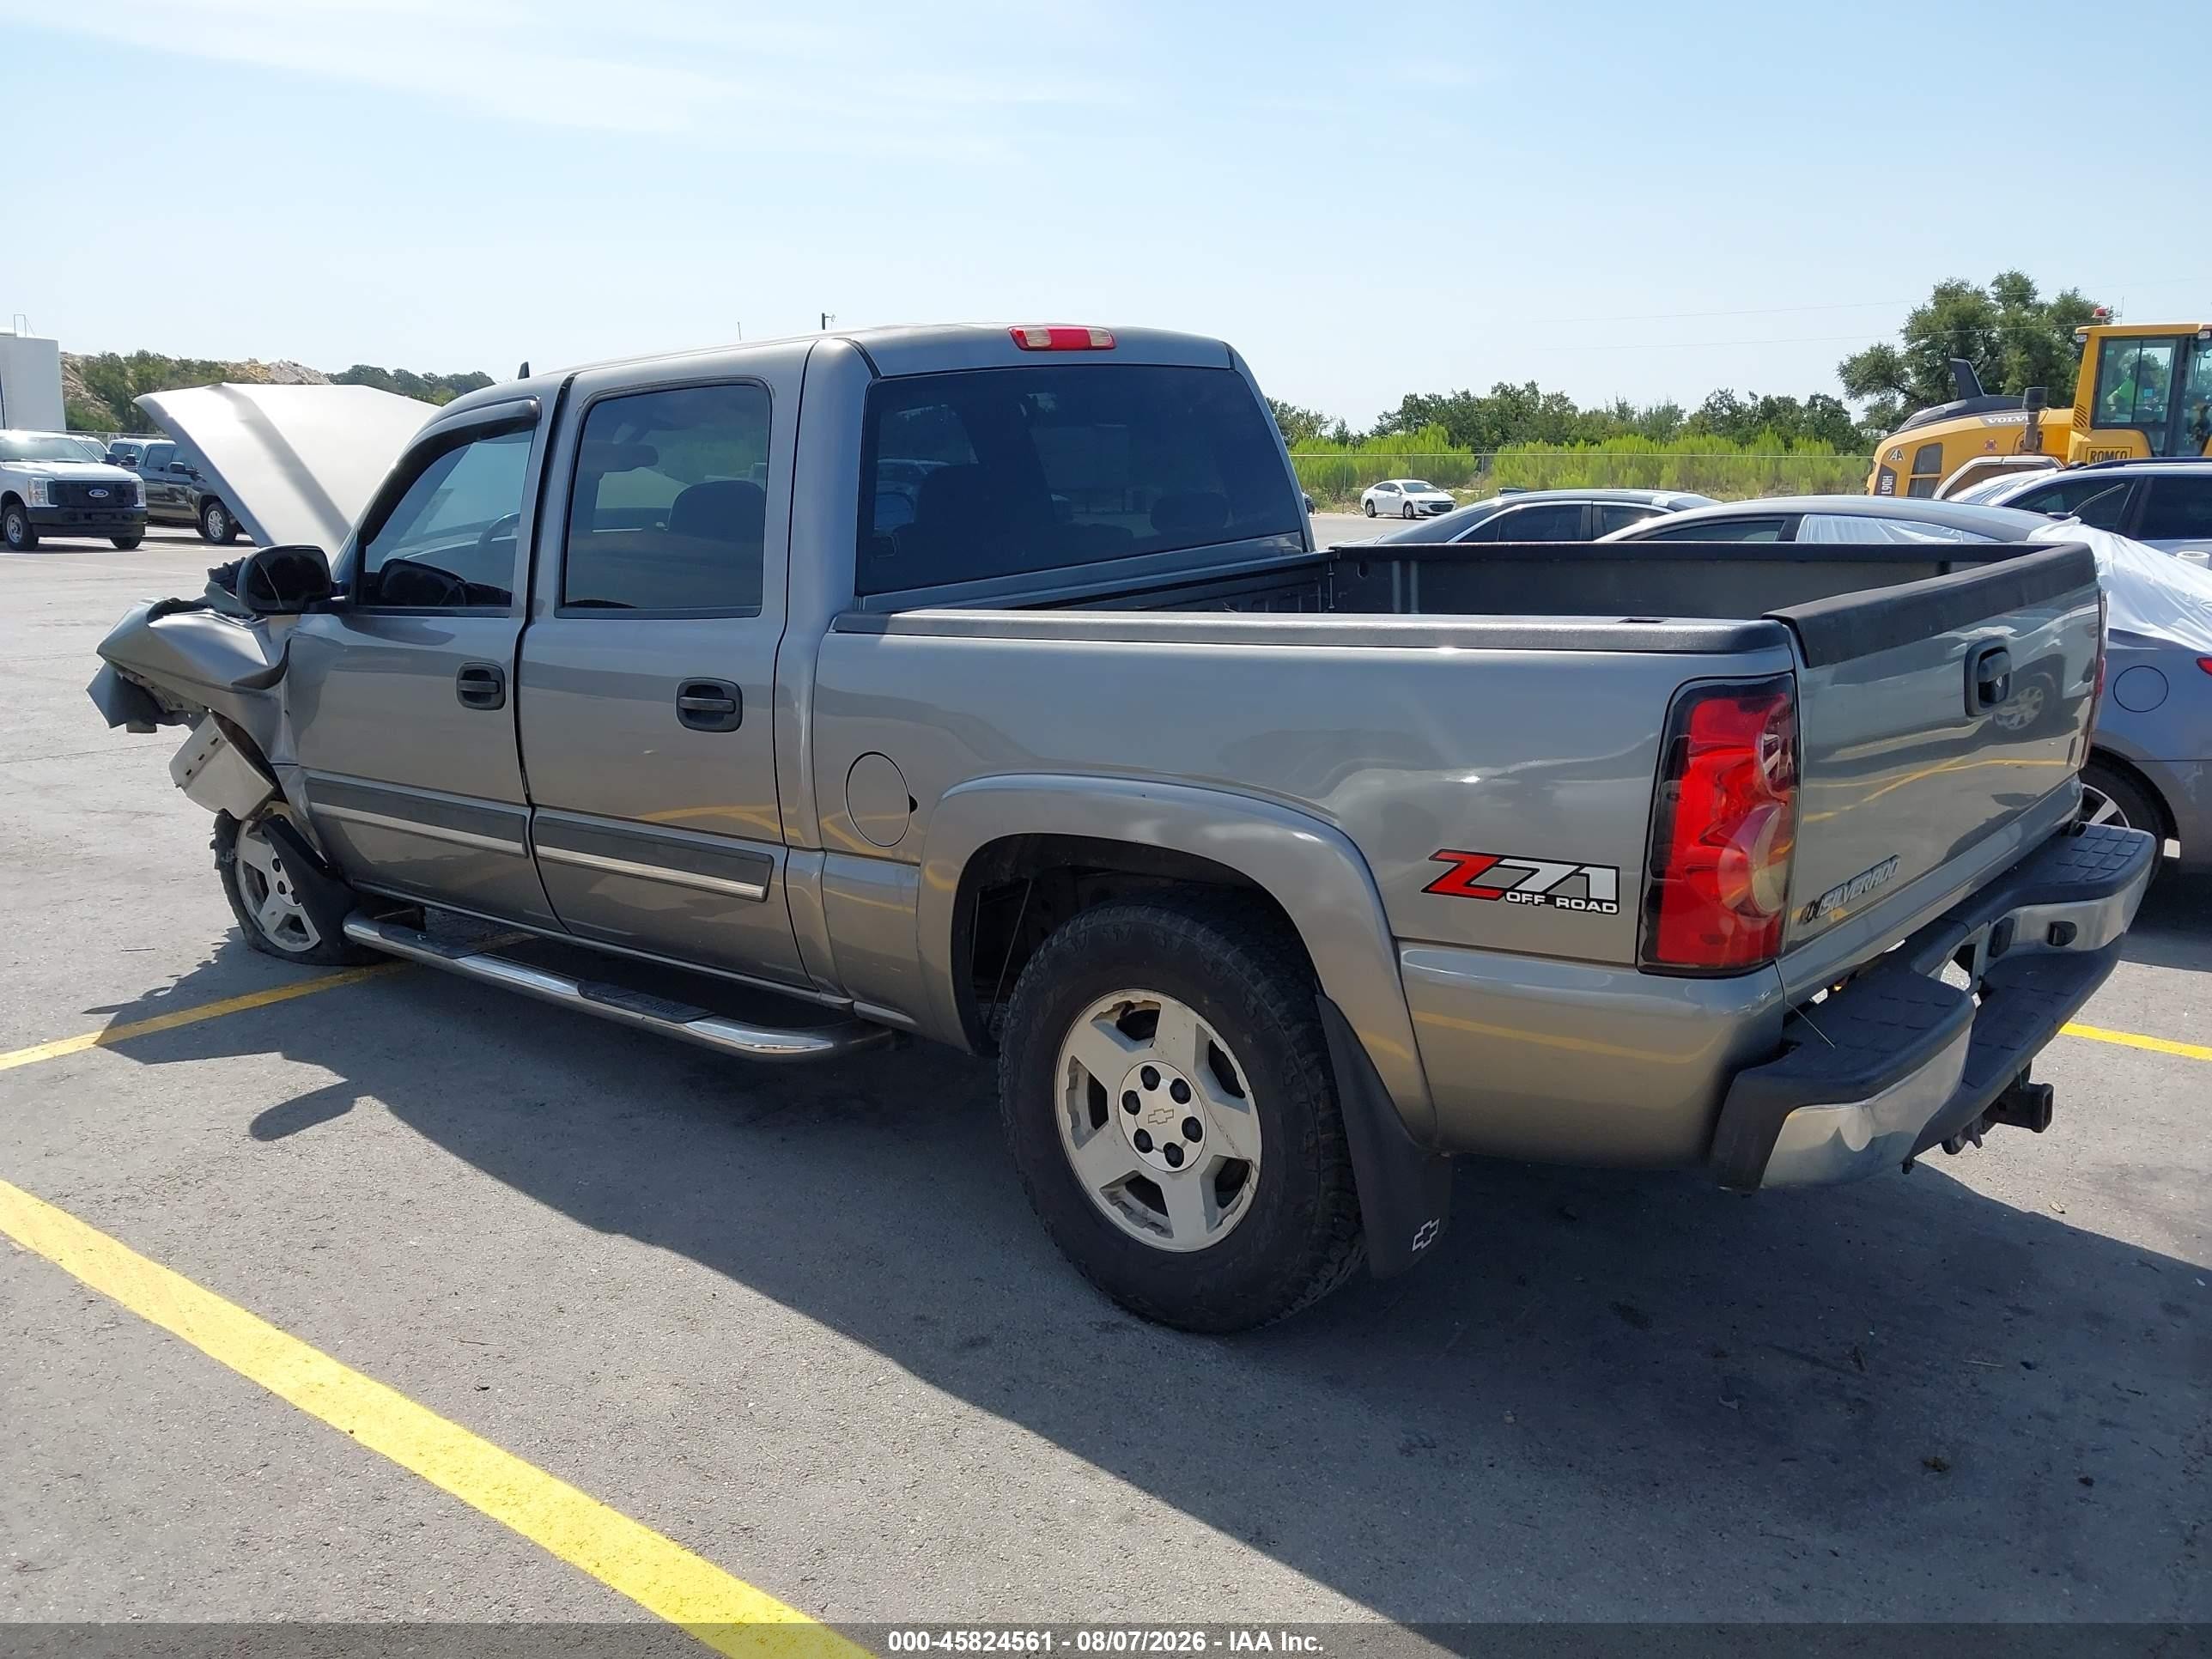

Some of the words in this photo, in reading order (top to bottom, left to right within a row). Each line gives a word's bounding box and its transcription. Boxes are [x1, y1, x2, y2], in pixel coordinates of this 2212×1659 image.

[2090, 450, 2128, 464] ROMCO
[1881, 475, 1893, 495] L90H
[1421, 848, 1620, 902] Z71
[1817, 854, 1901, 918] SILVERADO
[1505, 890, 1546, 906] OFF
[1555, 896, 1620, 915] ROAD
